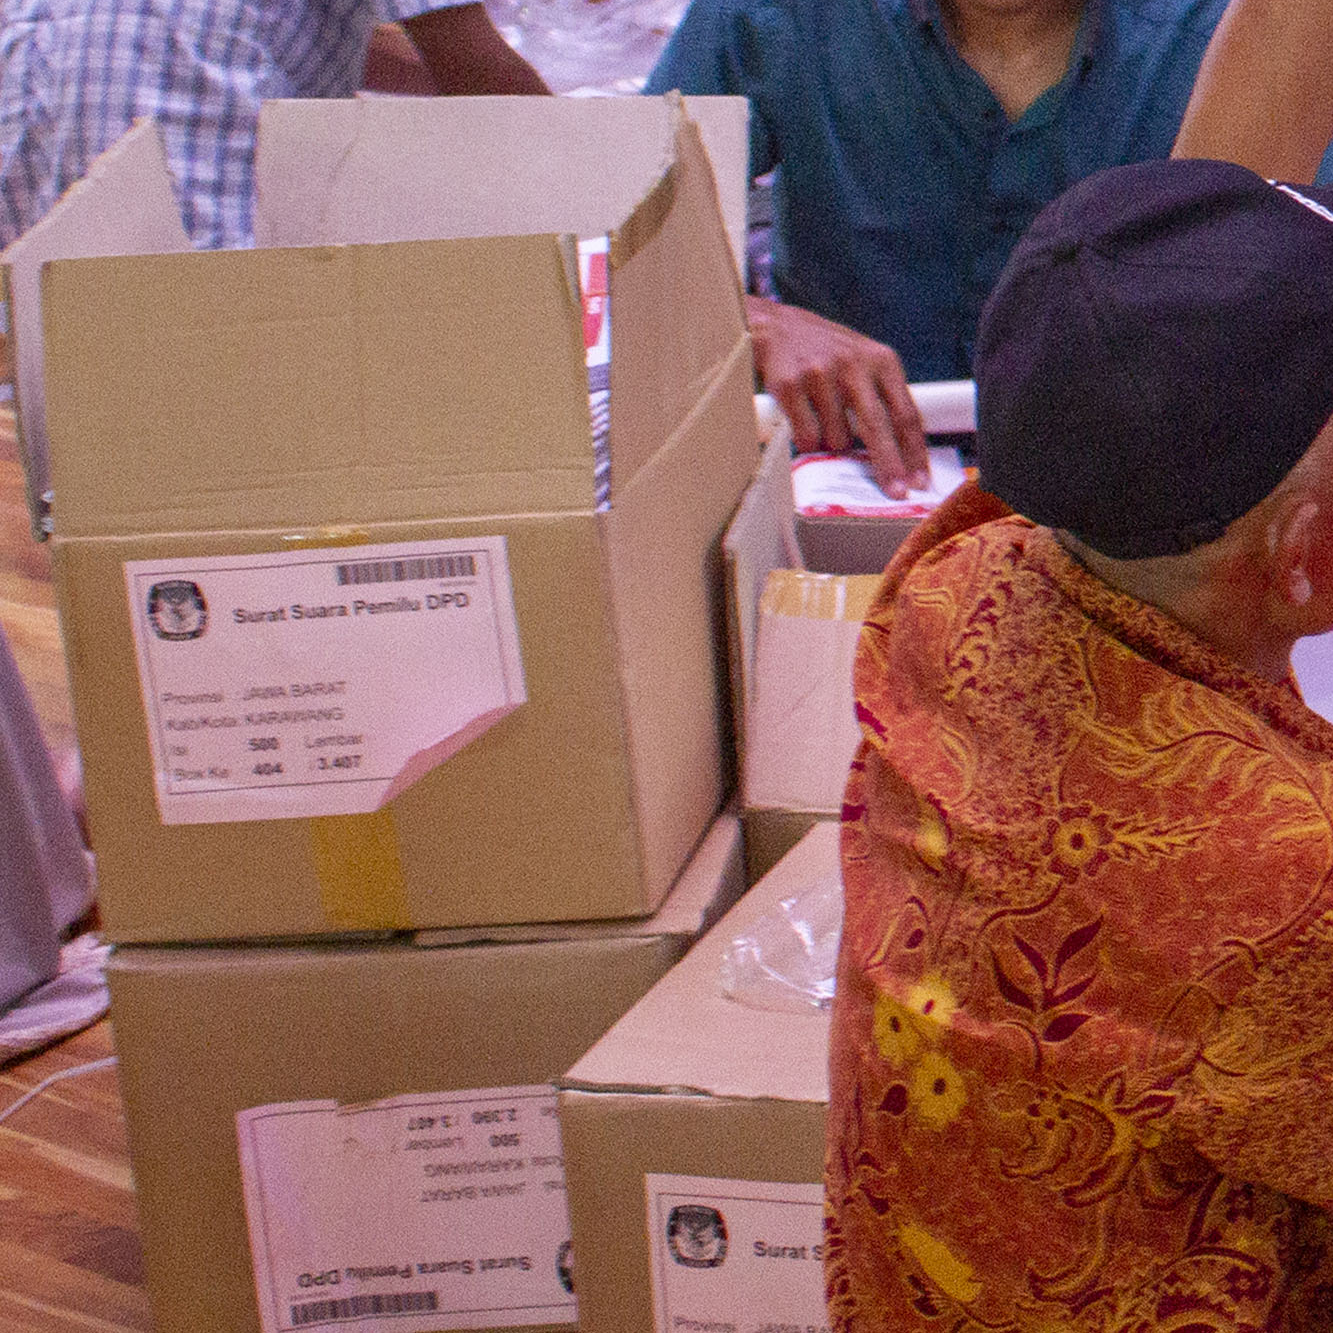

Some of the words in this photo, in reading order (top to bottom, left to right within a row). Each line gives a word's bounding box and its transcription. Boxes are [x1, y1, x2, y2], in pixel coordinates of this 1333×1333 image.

[232, 605, 288, 626] Surat
[291, 601, 348, 621] Suara
[352, 597, 421, 617] Pemilu
[425, 592, 470, 611] DPD
[243, 684, 287, 700] JAWA
[291, 680, 347, 697] BARAT
[244, 707, 345, 726] KARAWANG
[424, 1159, 523, 1177] KARAWANG
[421, 1186, 476, 1202] BARAT
[753, 1240, 807, 1260] Surat
[345, 1265, 412, 1279] Pemilu
[416, 1260, 474, 1274] Suara
[478, 1256, 531, 1271] Surat
[297, 1269, 340, 1288] DPD
